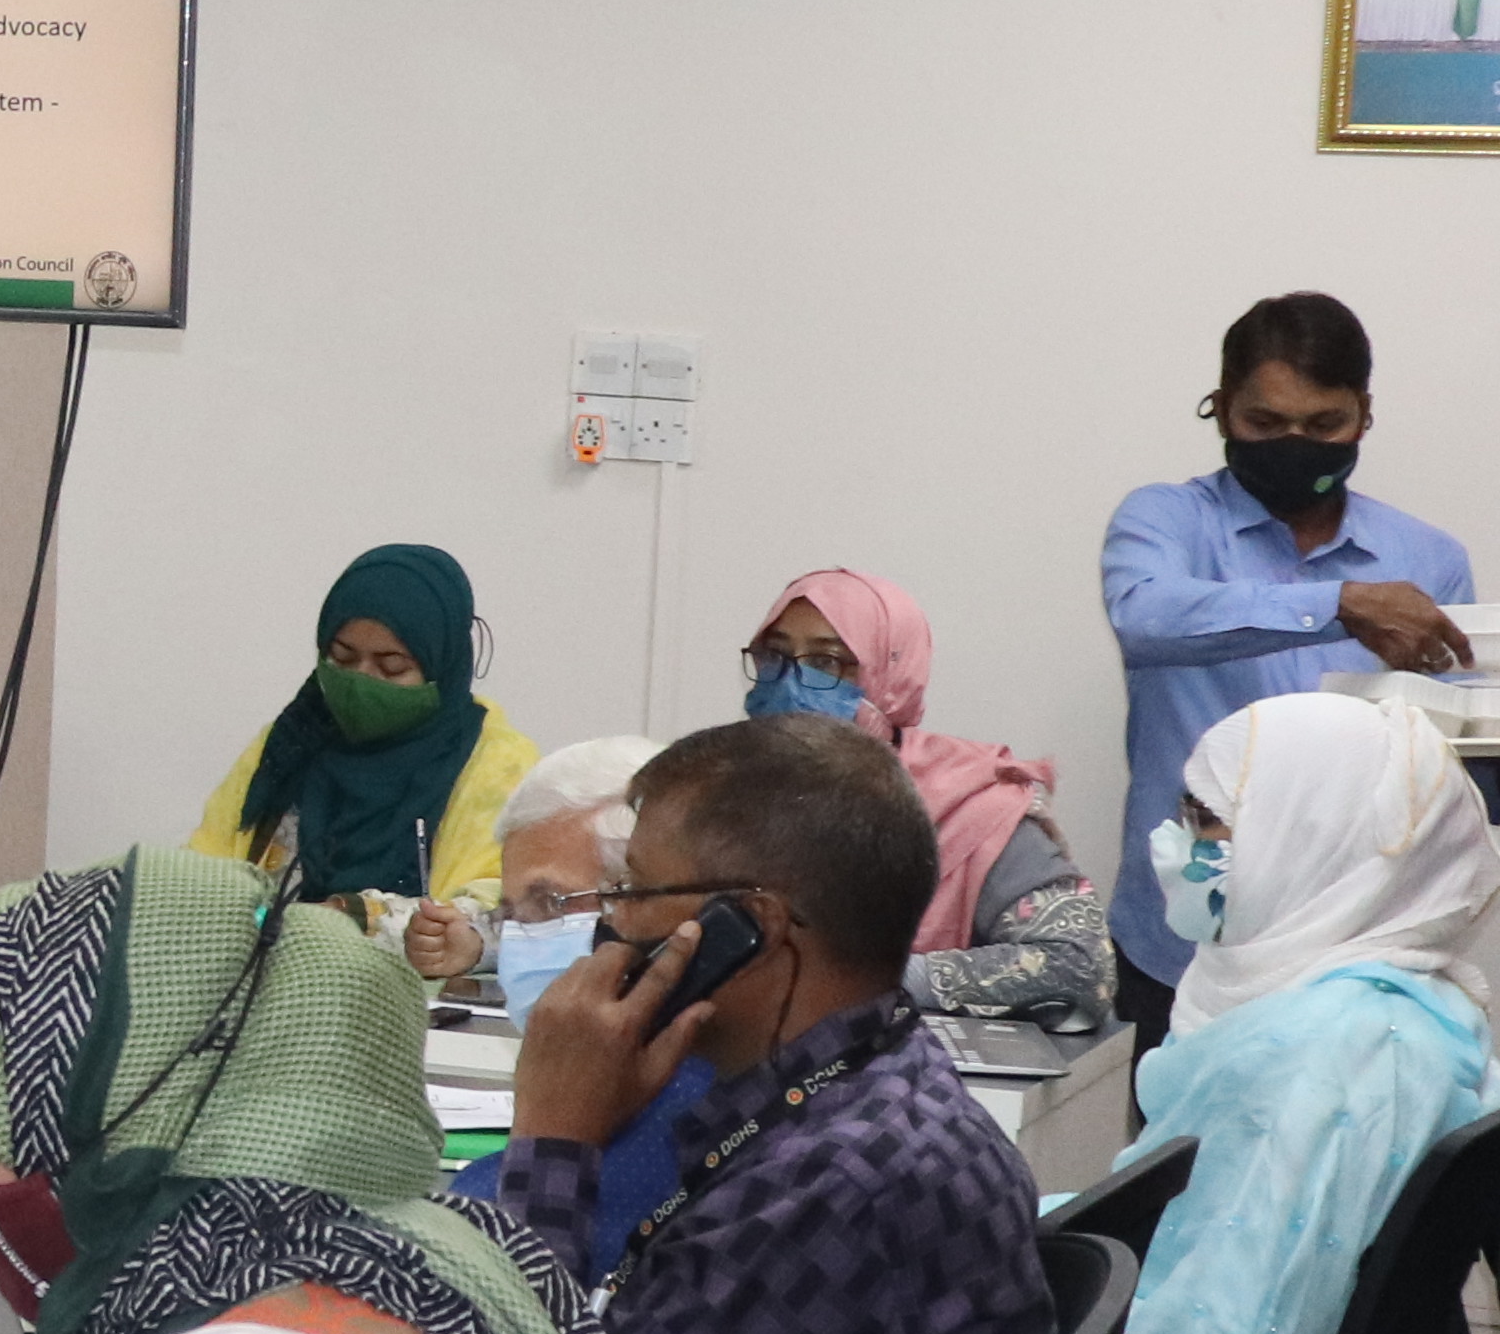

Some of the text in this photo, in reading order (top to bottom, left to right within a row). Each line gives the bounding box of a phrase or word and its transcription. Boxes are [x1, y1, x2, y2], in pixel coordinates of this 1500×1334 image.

[16, 256, 74, 272] Council
[720, 1118, 761, 1157] DGHS
[653, 1186, 689, 1224] DGHS
